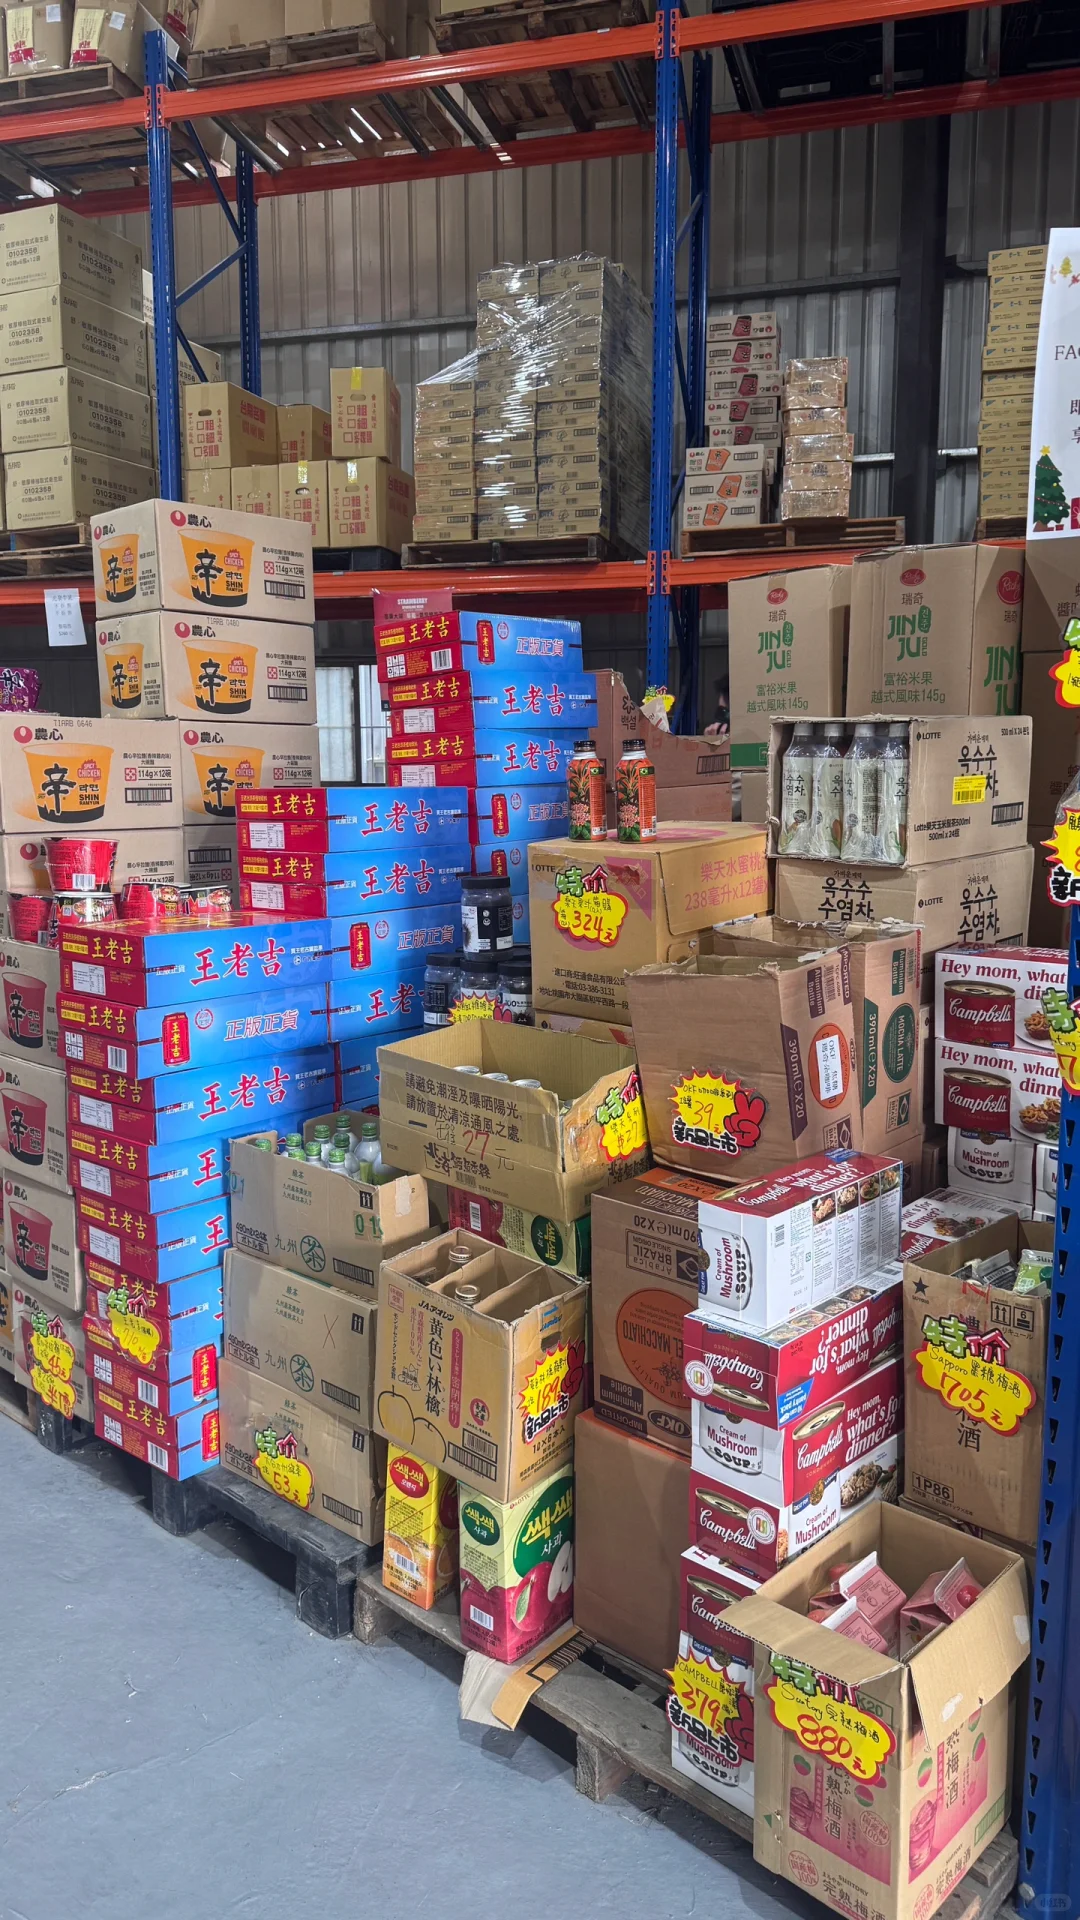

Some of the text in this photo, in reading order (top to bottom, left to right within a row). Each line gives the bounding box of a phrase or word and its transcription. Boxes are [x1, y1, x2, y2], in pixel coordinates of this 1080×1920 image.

[11, 327, 40, 338] 0102358
[18, 407, 47, 417] 0102358
[91, 411, 123, 428] 0102358
[187, 513, 212, 529] 農心
[194, 548, 224, 598] 辛
[224, 557, 245, 567] CHICKEN
[225, 571, 243, 581] 라면
[225, 580, 243, 589] SHIN
[901, 592, 924, 606] 瑞奇
[768, 609, 787, 622] 瑞奇
[887, 613, 917, 641] JIN
[1004, 610, 1018, 623] 瑞奇
[191, 624, 216, 638] 農心
[758, 629, 781, 654] JIN
[516, 636, 565, 657] 正版正貨
[896, 636, 921, 661] JU
[766, 650, 786, 673] JU
[198, 658, 228, 706] 辛
[229, 678, 246, 687] 라면
[756, 681, 798, 697] 富裕米果
[883, 671, 933, 687] 富裕米果
[502, 684, 565, 717] 王老吉
[746, 698, 809, 715] 越式風味145g
[870, 688, 946, 705] 越式風味145g
[34, 727, 63, 741] 農心
[620, 715, 637, 731] 백설
[922, 731, 941, 740] LOTTE
[200, 731, 224, 744] 農心
[957, 745, 997, 773] 옥수수
[77, 768, 101, 779] CHICKEN
[78, 783, 99, 793] 라면
[79, 793, 99, 801] SHIN
[361, 798, 433, 837] 王老吉
[359, 859, 435, 900] 王老吉
[555, 865, 609, 898] 特价
[821, 876, 873, 899] 옥수수
[818, 898, 873, 923] 수염차
[924, 896, 943, 907] LOTTE
[960, 884, 998, 915] 옥수수
[397, 924, 455, 950] 正版正貨
[572, 910, 605, 939] 324
[958, 908, 999, 942] 수염차
[189, 938, 286, 987] 王老吉
[842, 949, 850, 999] IMPORTED
[941, 958, 1067, 985] Hey mom, what
[365, 982, 426, 1024] 王老
[807, 968, 825, 1014] Aluminium Bottle
[949, 997, 1012, 1025] Campbell's
[223, 1009, 299, 1042] 正版正貨
[896, 1014, 905, 1073] MOCHA LATTE
[940, 1045, 1060, 1079] Hey mom, what
[198, 1066, 291, 1122] 王老吉
[947, 1084, 1008, 1114] Campbell's
[692, 1100, 714, 1131] 39
[462, 1129, 490, 1161] 27
[673, 1117, 739, 1155] 新品上市
[962, 1149, 1009, 1169] Mushroom
[973, 1147, 999, 1158] Cream of
[791, 1160, 854, 1188] what's for
[810, 1170, 864, 1194] dinner?
[968, 1164, 1003, 1180] SOUP
[275, 1234, 297, 1256] 九州
[302, 1237, 325, 1272] 茶
[632, 1235, 671, 1252] SINGLE ORIGIN
[633, 1244, 672, 1266] BRAZIL
[899, 1233, 935, 1263] ampbell's
[633, 1256, 672, 1275] Arabica
[719, 1237, 734, 1299] Mushroom
[735, 1248, 748, 1294] SOUP
[106, 1286, 147, 1318] 特价
[418, 1299, 455, 1322] JAアオレン
[1020, 1310, 1027, 1320] 6
[622, 1319, 672, 1354] MACCHIATO
[818, 1305, 868, 1354] dinner?
[921, 1314, 1011, 1367] 特价
[264, 1350, 288, 1373] 九州
[809, 1328, 870, 1376] what's for
[929, 1346, 969, 1377] Sapporo
[290, 1354, 314, 1392] 茶
[424, 1316, 445, 1418] 黄色い林檎
[536, 1376, 562, 1414] 189
[601, 1379, 643, 1412] Aluminium Bottle
[846, 1394, 882, 1422] Hey mom,
[526, 1393, 570, 1441] 新品上市
[601, 1407, 643, 1431] IMPORTED
[655, 1417, 685, 1435] OKF
[707, 1425, 758, 1457] Mushroom
[719, 1425, 747, 1442] Cream of
[844, 1414, 896, 1463] dinner?
[713, 1446, 751, 1469] SOUP
[272, 1471, 291, 1494] 53
[394, 1461, 424, 1489] 쌕쌕
[400, 1478, 417, 1492] 오렌지
[914, 1475, 951, 1501] 1P86
[465, 1505, 495, 1533] 쌕쌕
[521, 1486, 573, 1546] 쌕쌕
[699, 1507, 757, 1551] Campbell's
[794, 1509, 838, 1545] Mushroom
[805, 1504, 829, 1527] Cream of
[473, 1525, 488, 1539] 사과
[541, 1530, 563, 1557] 사과
[678, 1661, 719, 1691] CAMPBELL
[669, 1696, 739, 1764] 新品上市
[796, 1713, 853, 1759] 880
[838, 1874, 870, 1897] SUNTORY
[822, 1879, 887, 1920] 完熟梅酒
